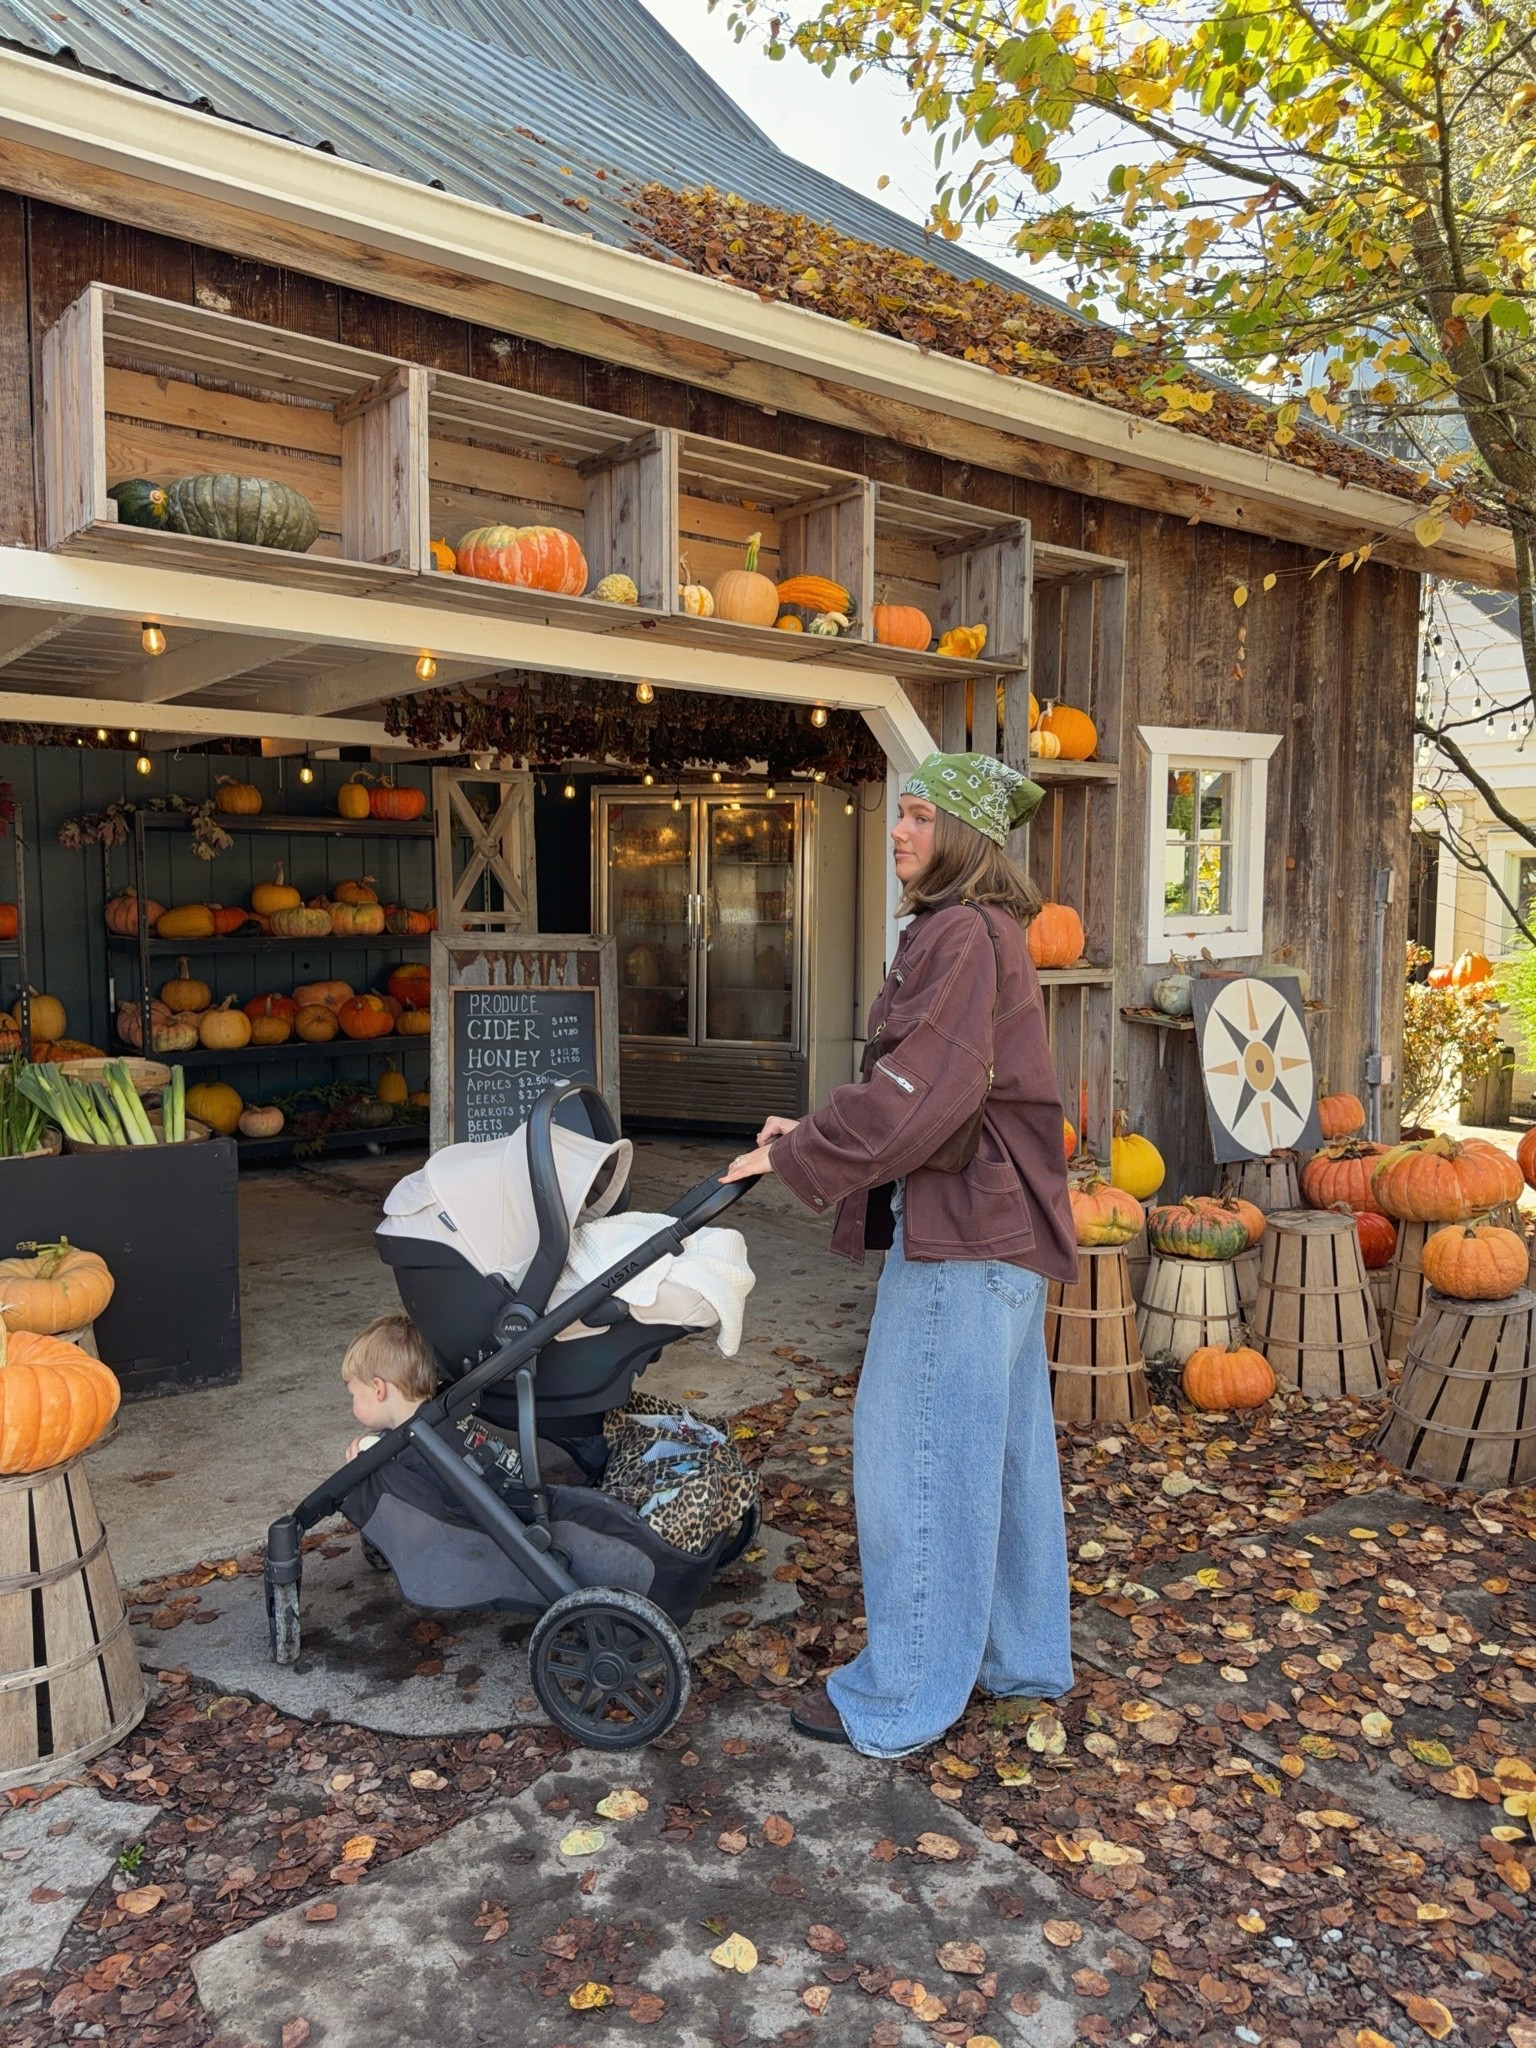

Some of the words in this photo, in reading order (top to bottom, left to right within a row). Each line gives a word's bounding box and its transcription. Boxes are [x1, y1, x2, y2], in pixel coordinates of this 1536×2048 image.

[469, 994, 539, 1015] PRODUCE
[551, 1016, 558, 1026] S
[467, 1019, 540, 1041] CIDER
[552, 1030, 558, 1038] L
[467, 1048, 541, 1069] HONEY
[550, 1048, 556, 1057] S
[551, 1058, 557, 1066] L
[467, 1077, 512, 1092] APPLES
[466, 1093, 506, 1106] LEEKS
[467, 1106, 515, 1119] CARROTS
[468, 1118, 503, 1133] BEETS
[601, 1261, 640, 1289] VISTA
[504, 1324, 528, 1332] MESA
